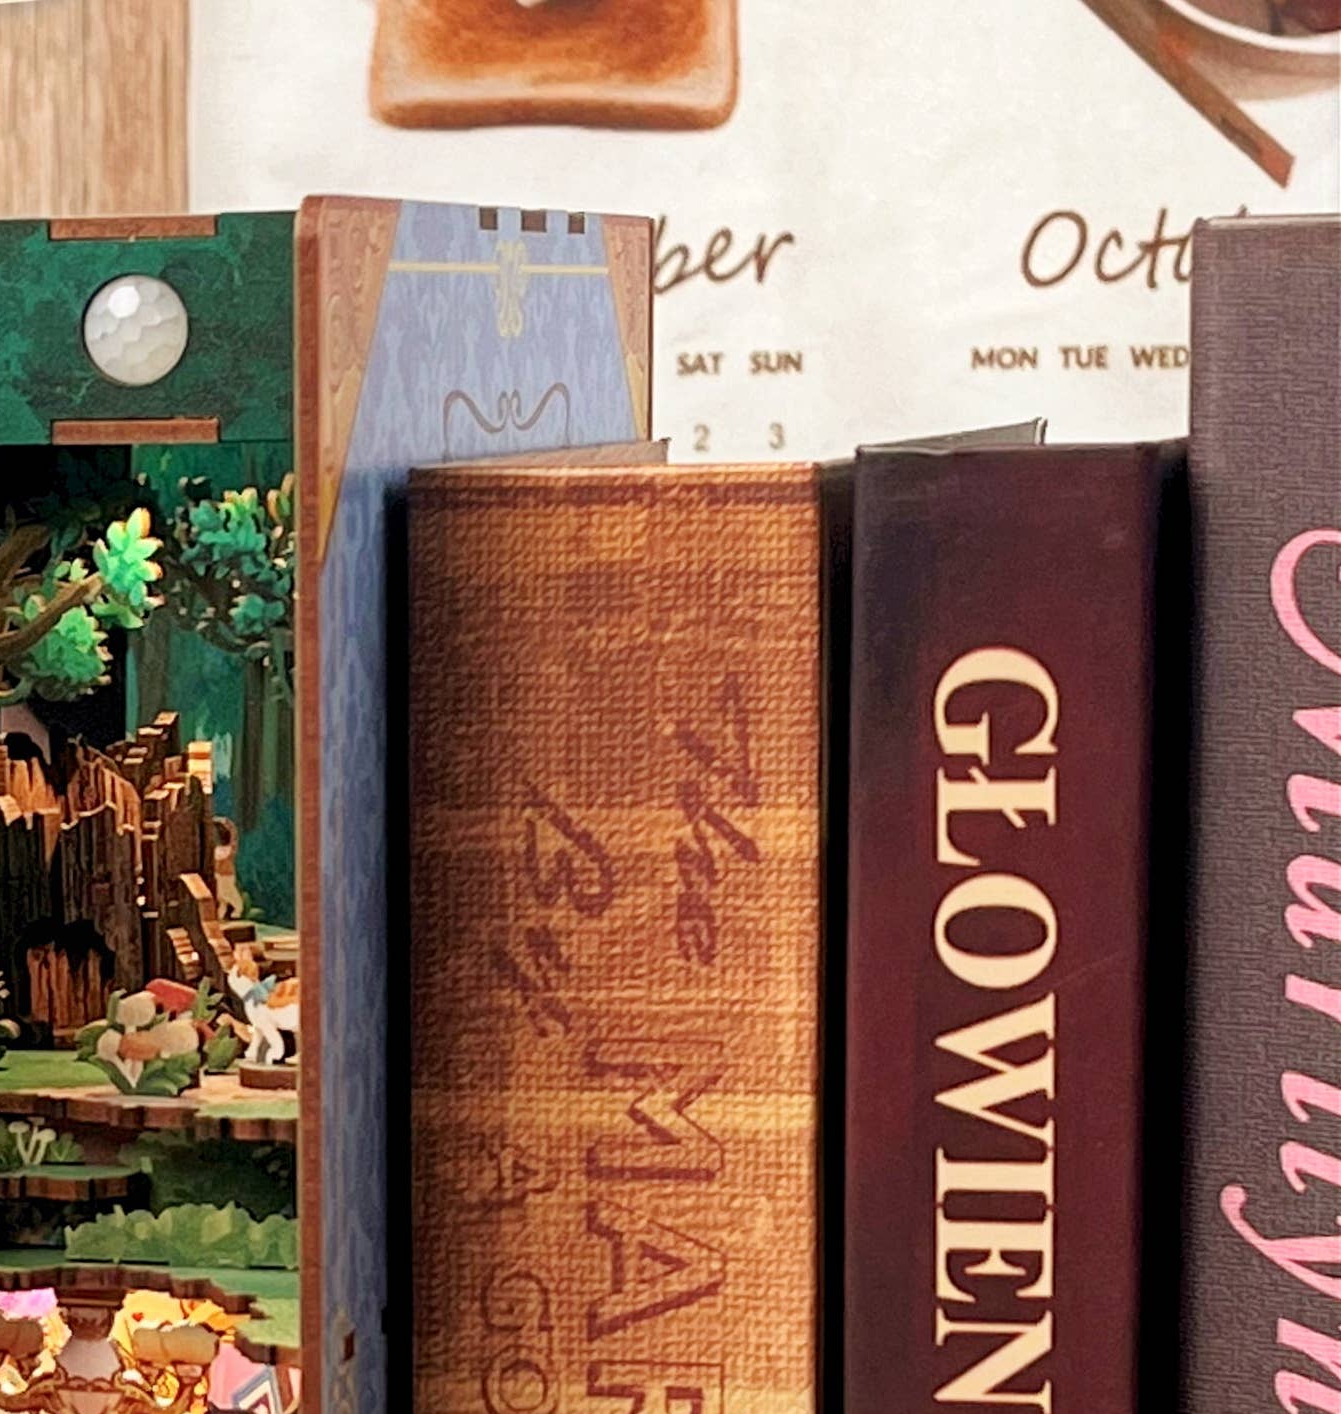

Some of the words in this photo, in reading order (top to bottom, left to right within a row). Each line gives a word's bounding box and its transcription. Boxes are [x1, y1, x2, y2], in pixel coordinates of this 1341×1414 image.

[676, 352, 723, 376] SAT
[750, 351, 803, 375] SUN
[971, 347, 1038, 369] MON
[1059, 345, 1108, 369] TUE
[1130, 345, 1190, 369] WED
[694, 424, 710, 451] 2
[769, 422, 785, 450] 3
[675, 675, 761, 966] The
